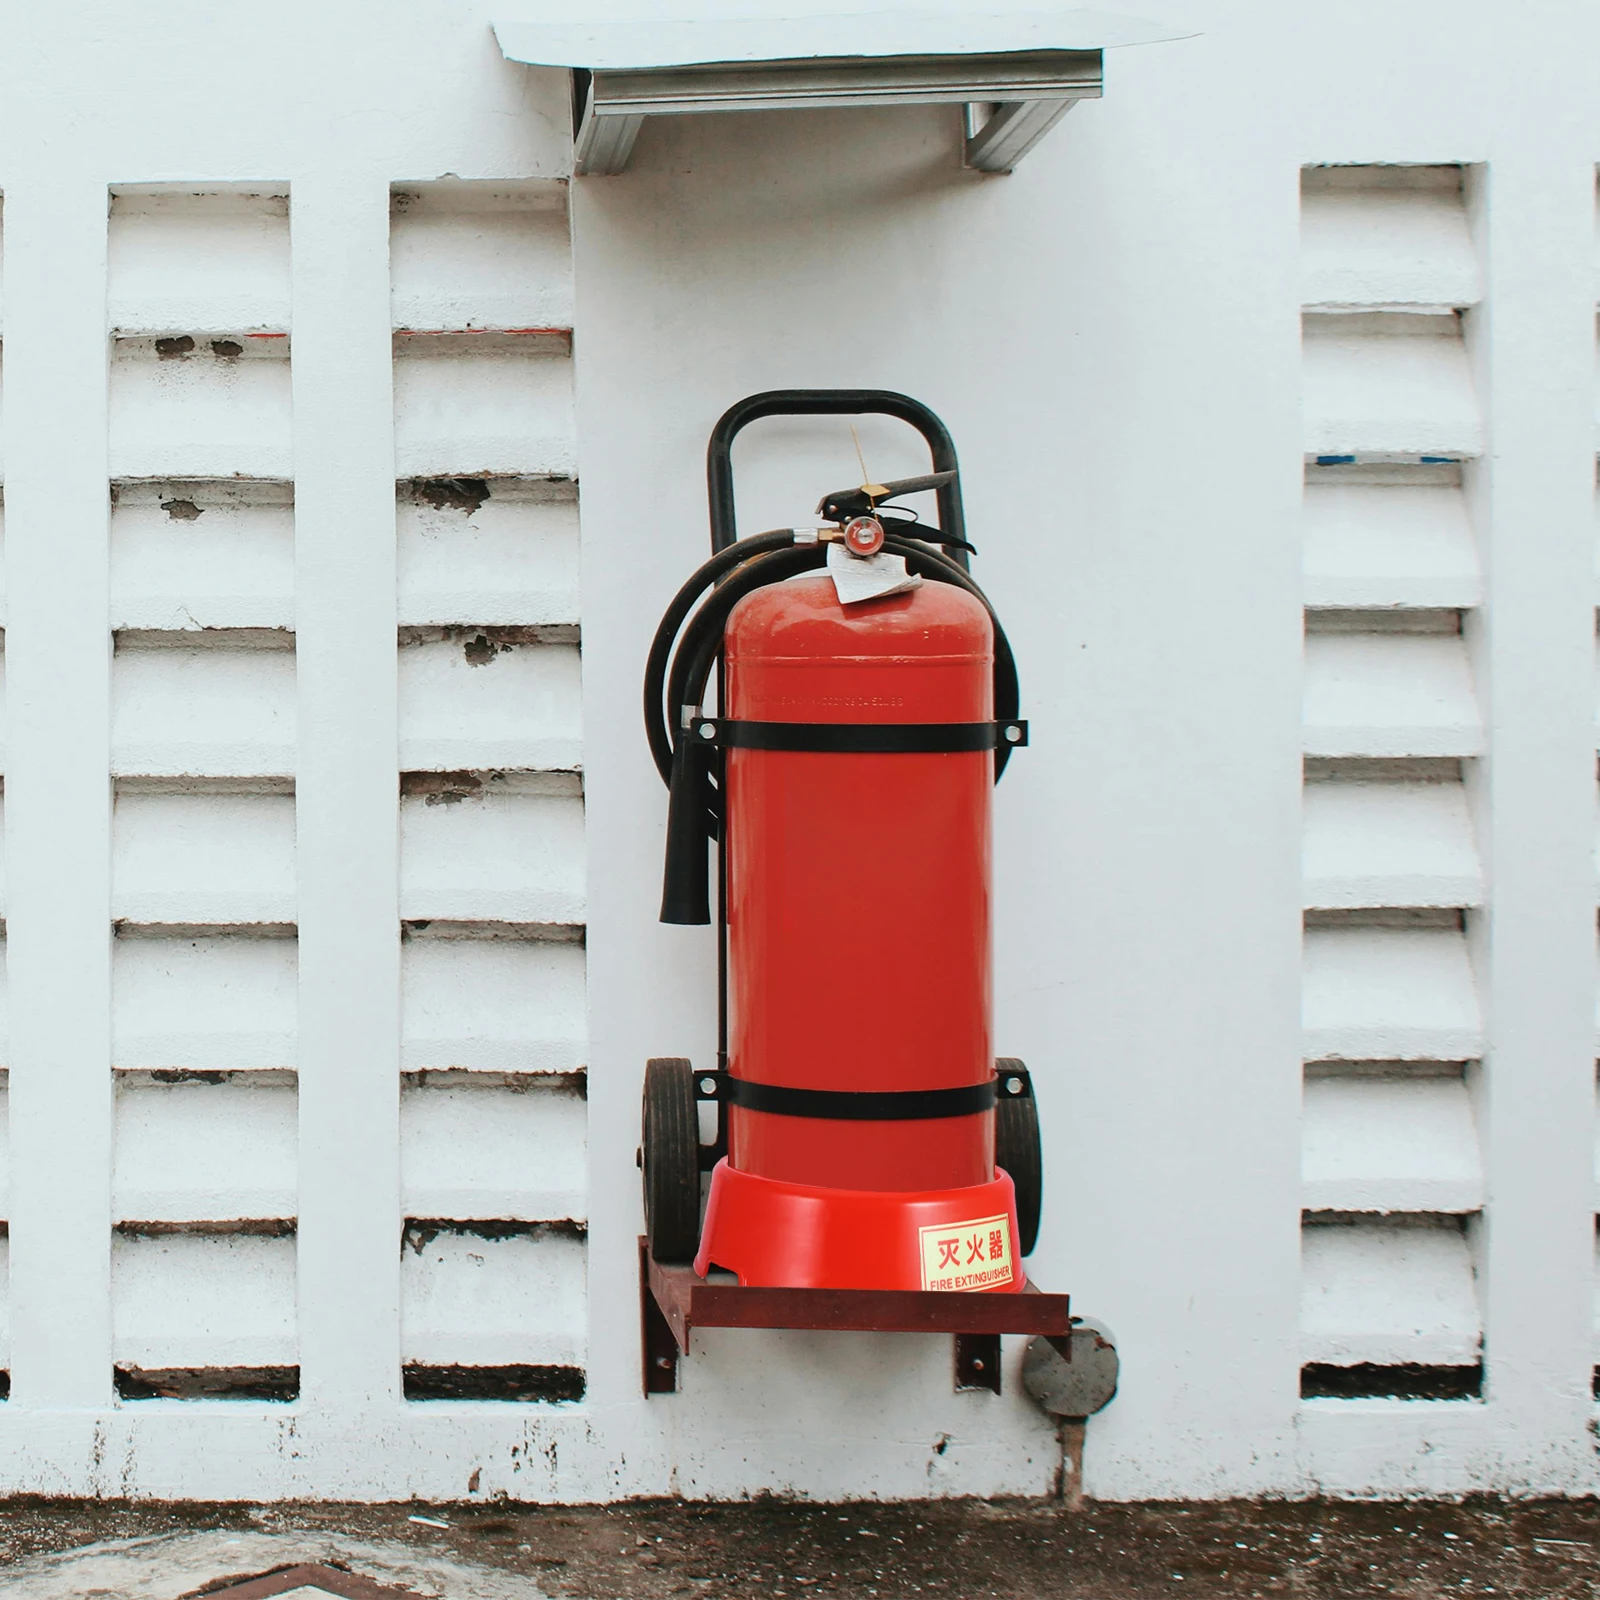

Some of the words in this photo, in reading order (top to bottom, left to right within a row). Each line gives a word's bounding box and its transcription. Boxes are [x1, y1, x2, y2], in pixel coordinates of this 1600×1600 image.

[937, 1229, 1003, 1270] 灭火器
[930, 1277, 953, 1291] FIRE
[955, 1265, 1010, 1288] EXTINGUISHER
